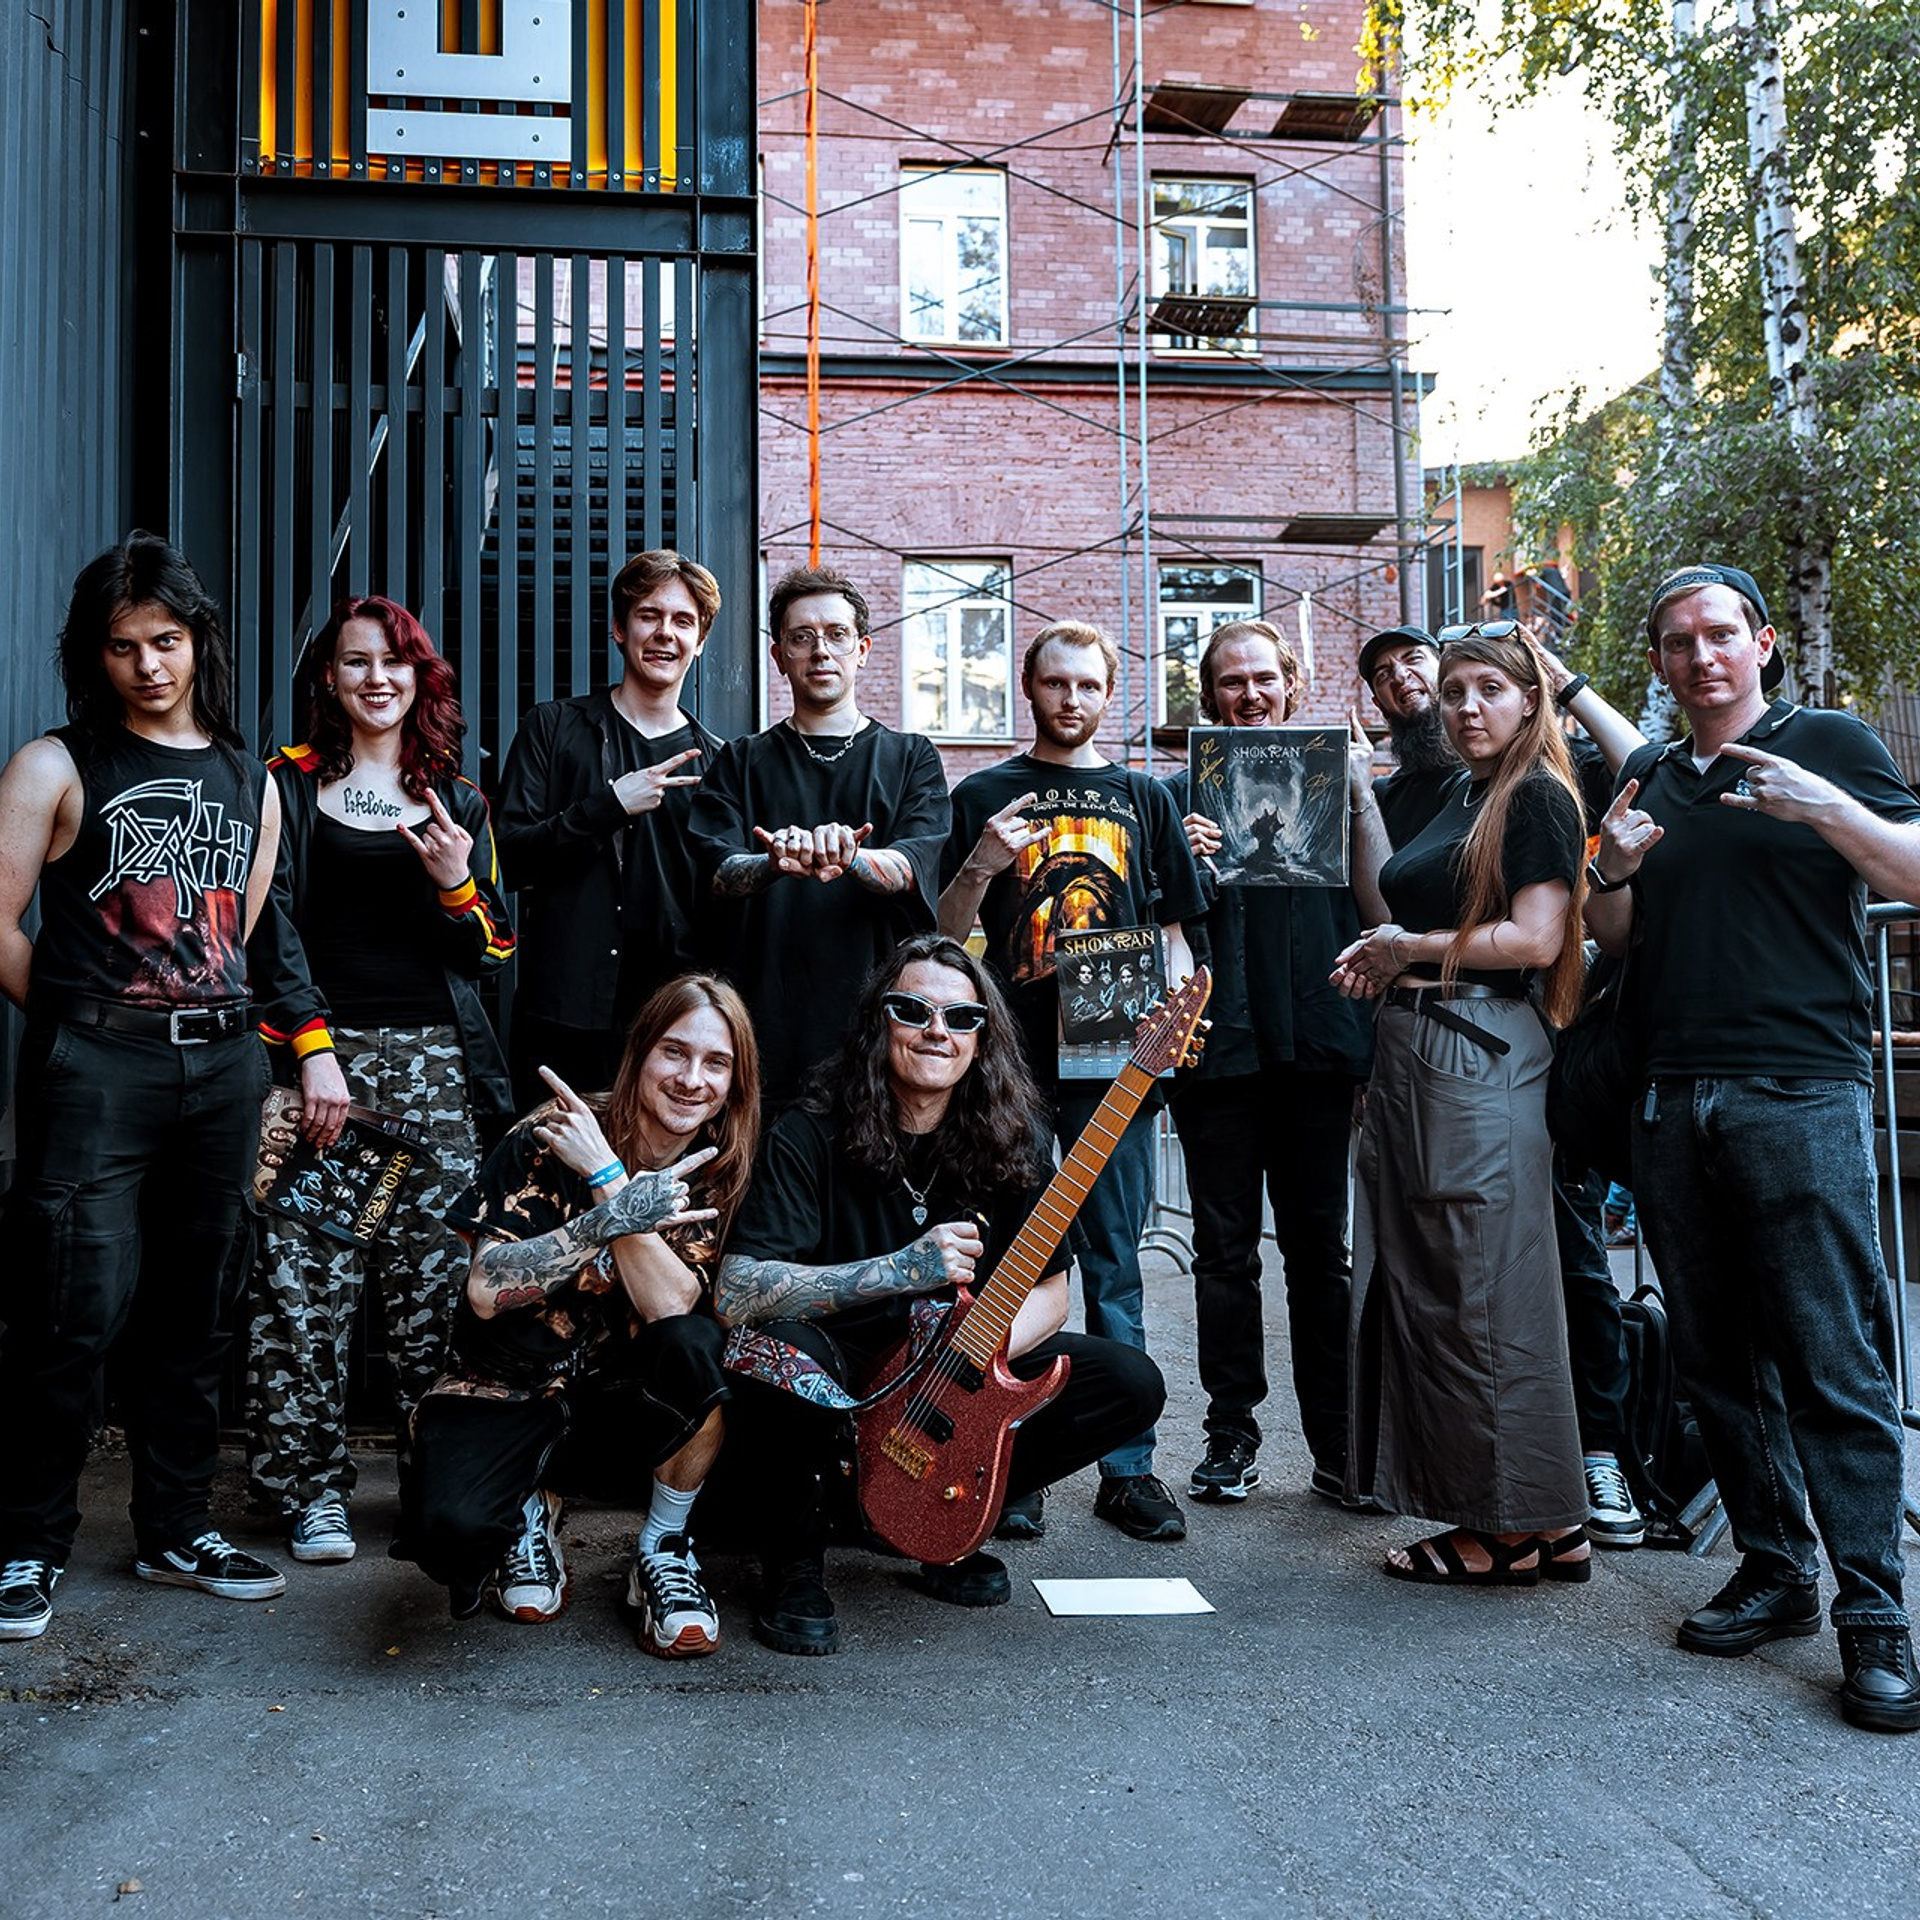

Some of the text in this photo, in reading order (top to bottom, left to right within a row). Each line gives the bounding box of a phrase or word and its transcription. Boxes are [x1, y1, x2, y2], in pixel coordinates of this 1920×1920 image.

[1232, 744, 1300, 759] SHOKRAN
[89, 779, 253, 919] DEATH
[1063, 931, 1156, 956] SHOKRAN
[354, 1150, 412, 1242] SHOKRAN
